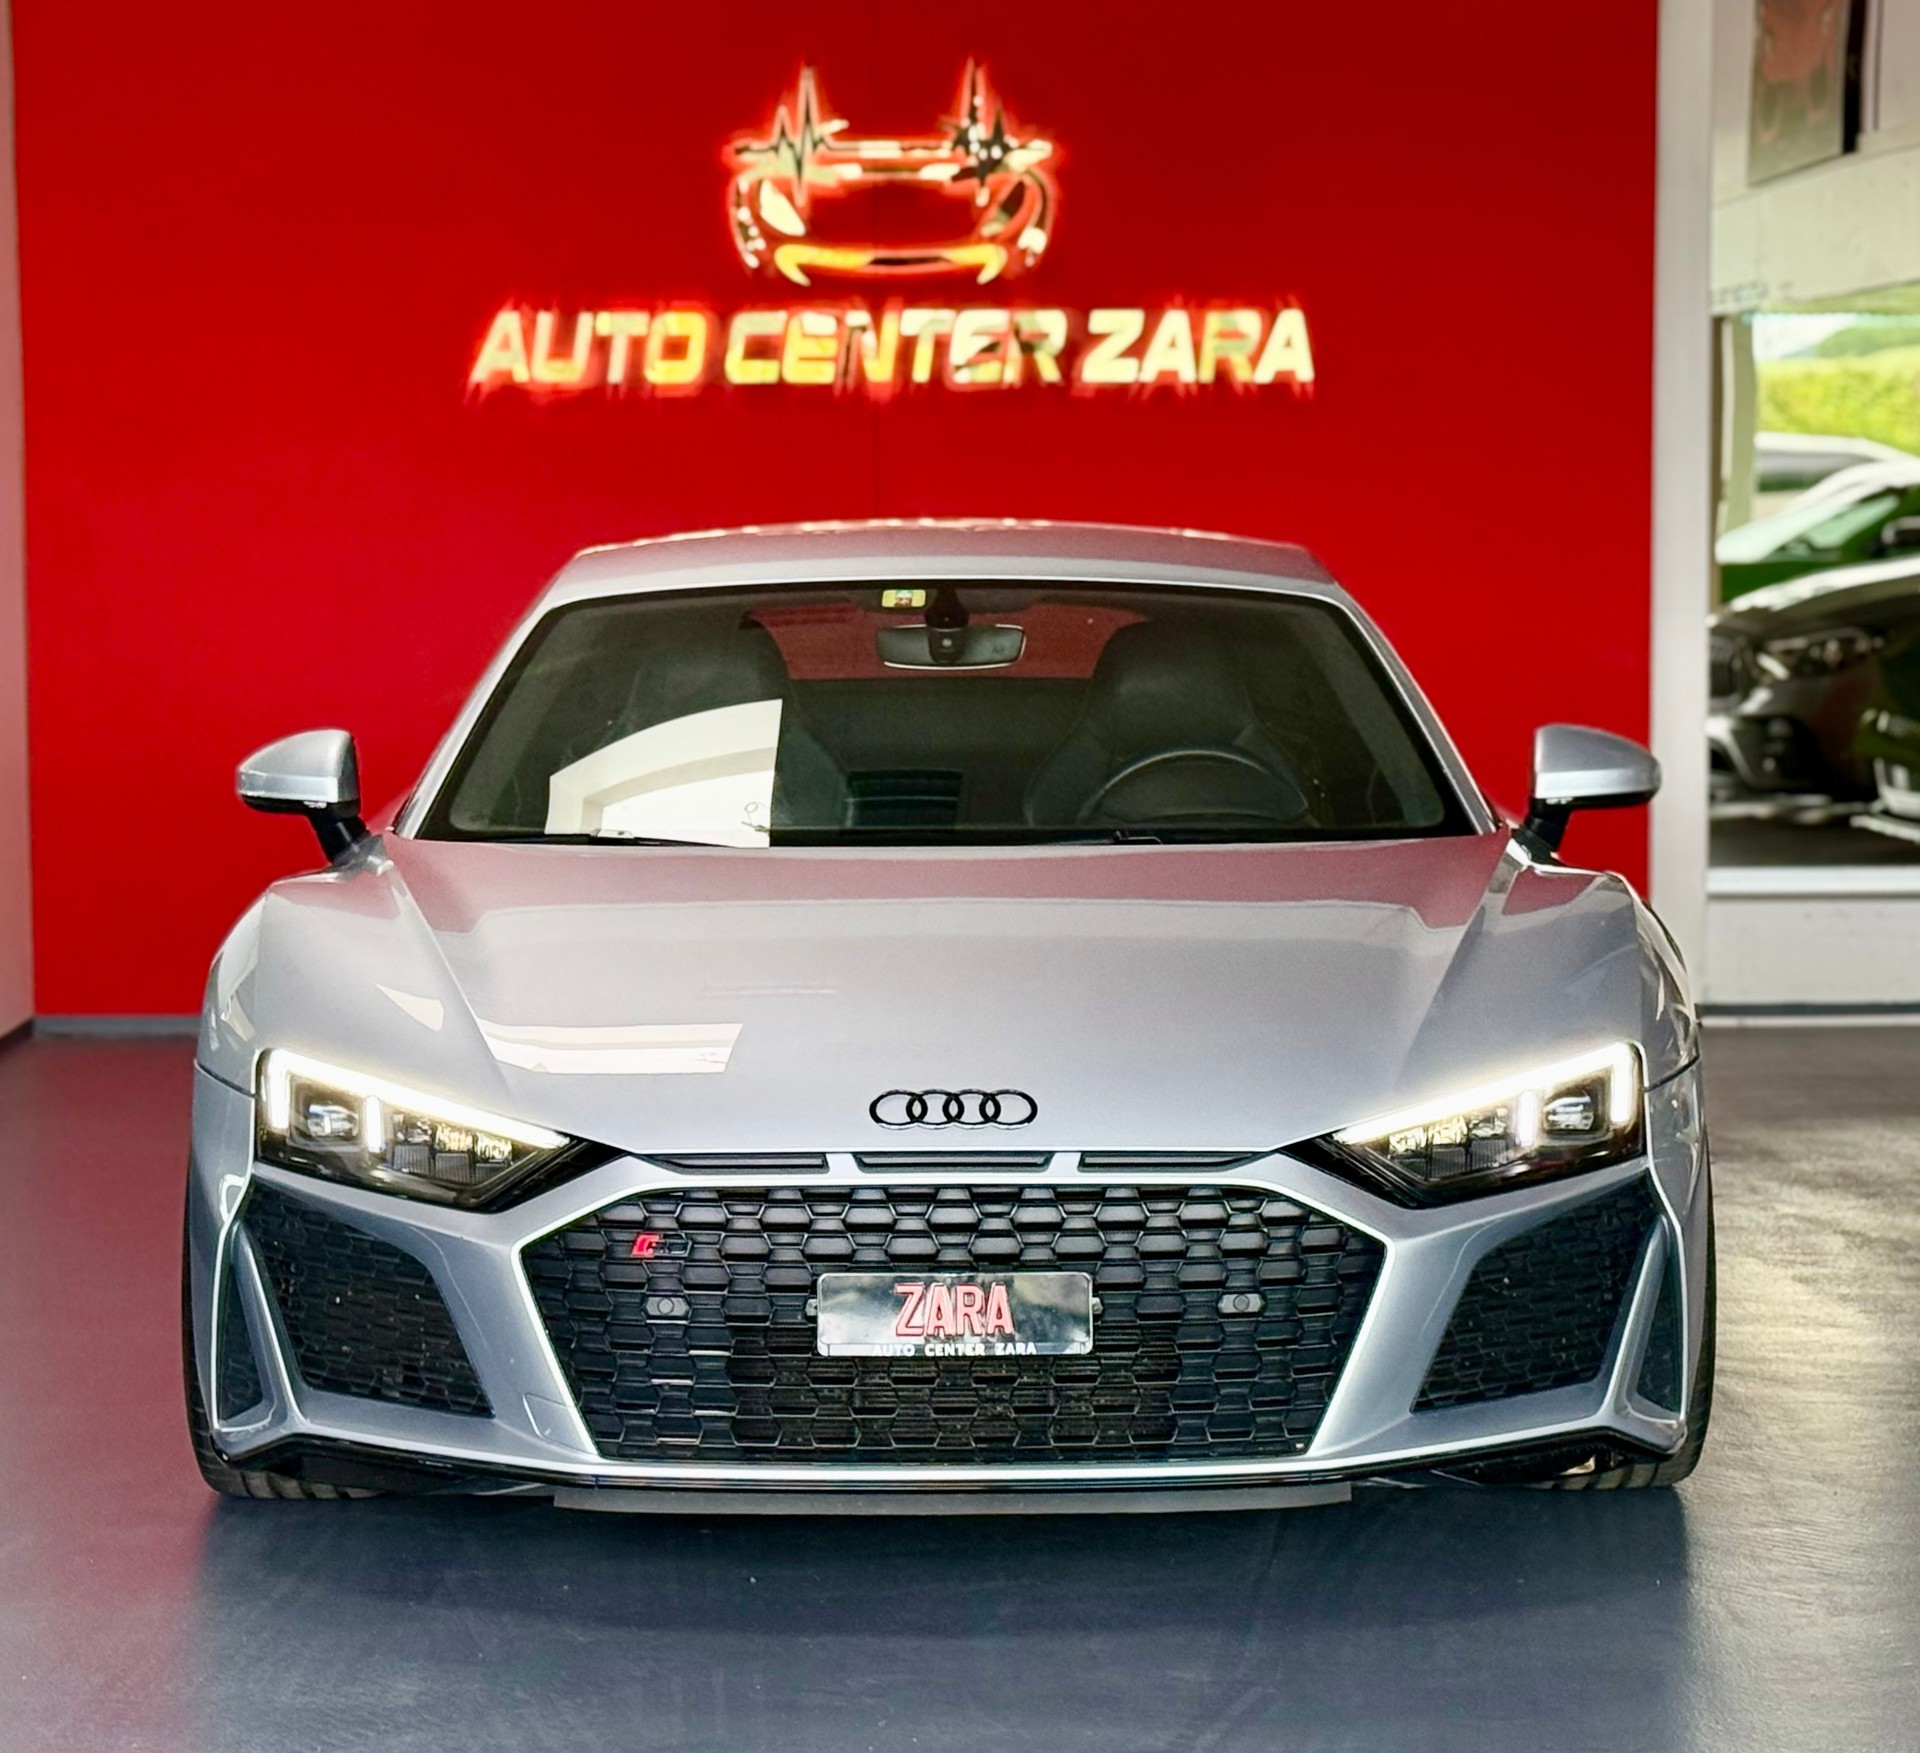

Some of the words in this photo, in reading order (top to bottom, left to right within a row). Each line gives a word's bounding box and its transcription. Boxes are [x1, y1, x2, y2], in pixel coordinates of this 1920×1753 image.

[470, 310, 707, 384] AUTO
[724, 309, 1067, 384] CENTER
[1081, 308, 1315, 384] ZARA
[894, 1282, 1014, 1337] ZARA
[873, 1342, 916, 1357] AUTO
[924, 1342, 985, 1357] CENTER
[994, 1342, 1037, 1356] ZARA
